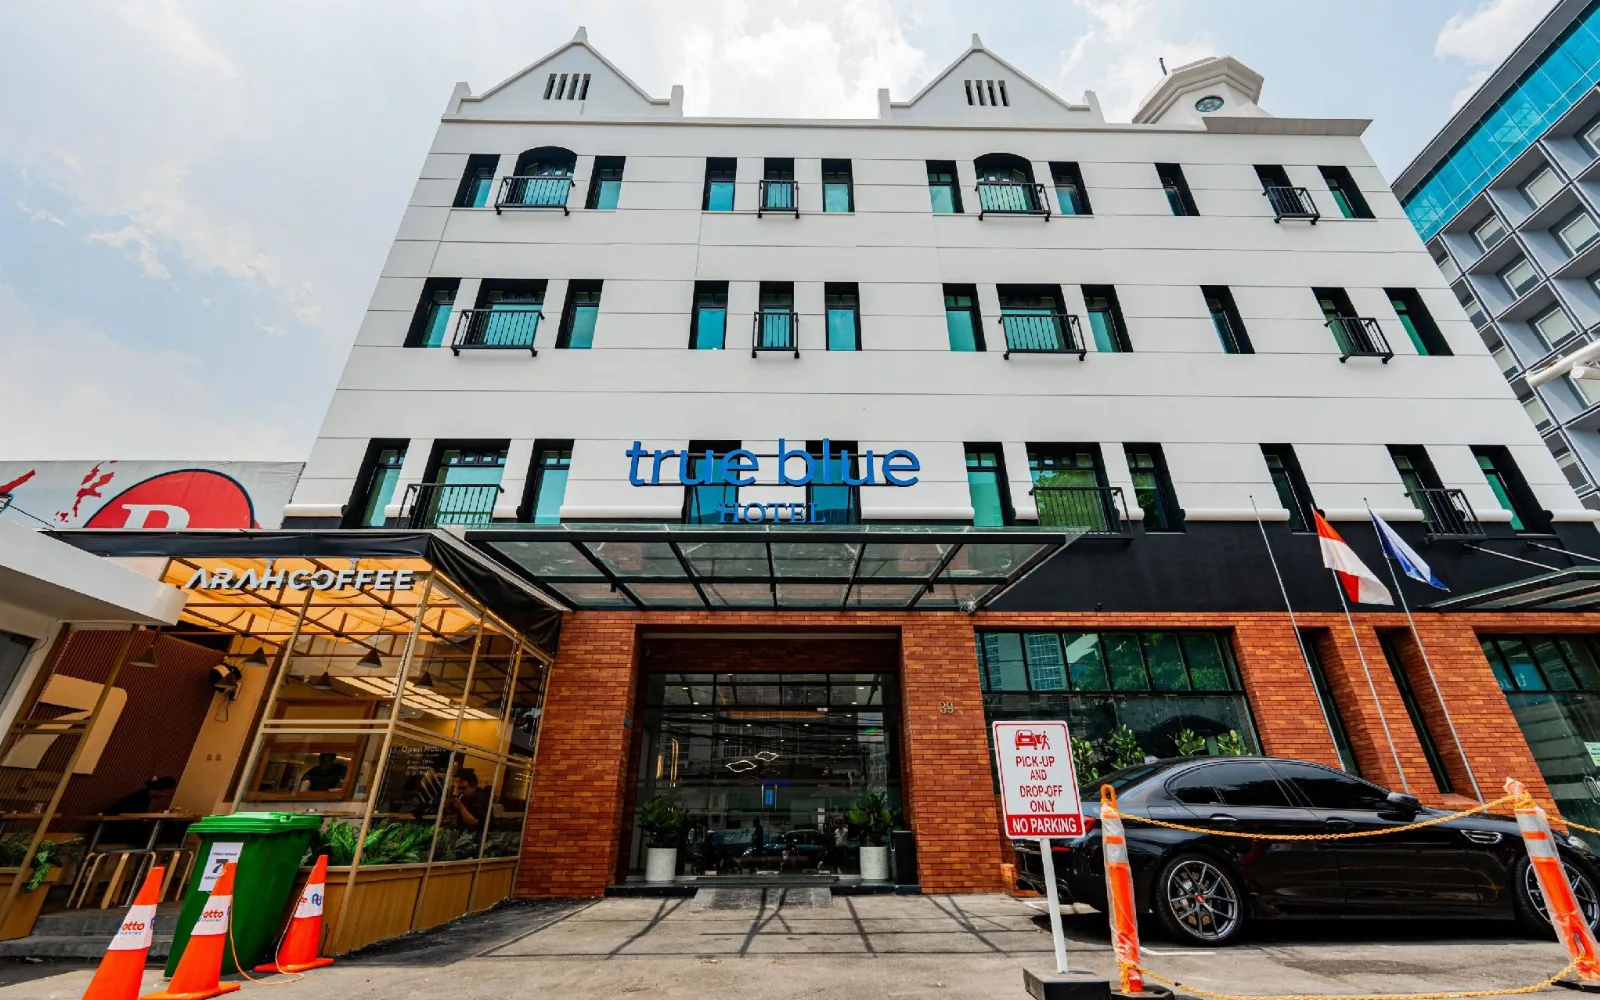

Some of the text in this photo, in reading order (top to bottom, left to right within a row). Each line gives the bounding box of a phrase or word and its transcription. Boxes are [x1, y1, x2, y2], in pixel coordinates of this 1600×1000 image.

[626, 438, 921, 487] true blue
[718, 502, 826, 524] HOTEL
[940, 701, 955, 714] 39
[1016, 755, 1055, 768] PICK-UP
[1030, 769, 1047, 781] AND
[1019, 785, 1063, 798] DROP-OFF
[1029, 800, 1055, 813] ONLY
[1012, 817, 1077, 833] NO PARKING
[203, 909, 224, 919] otto
[122, 921, 145, 931] otto
